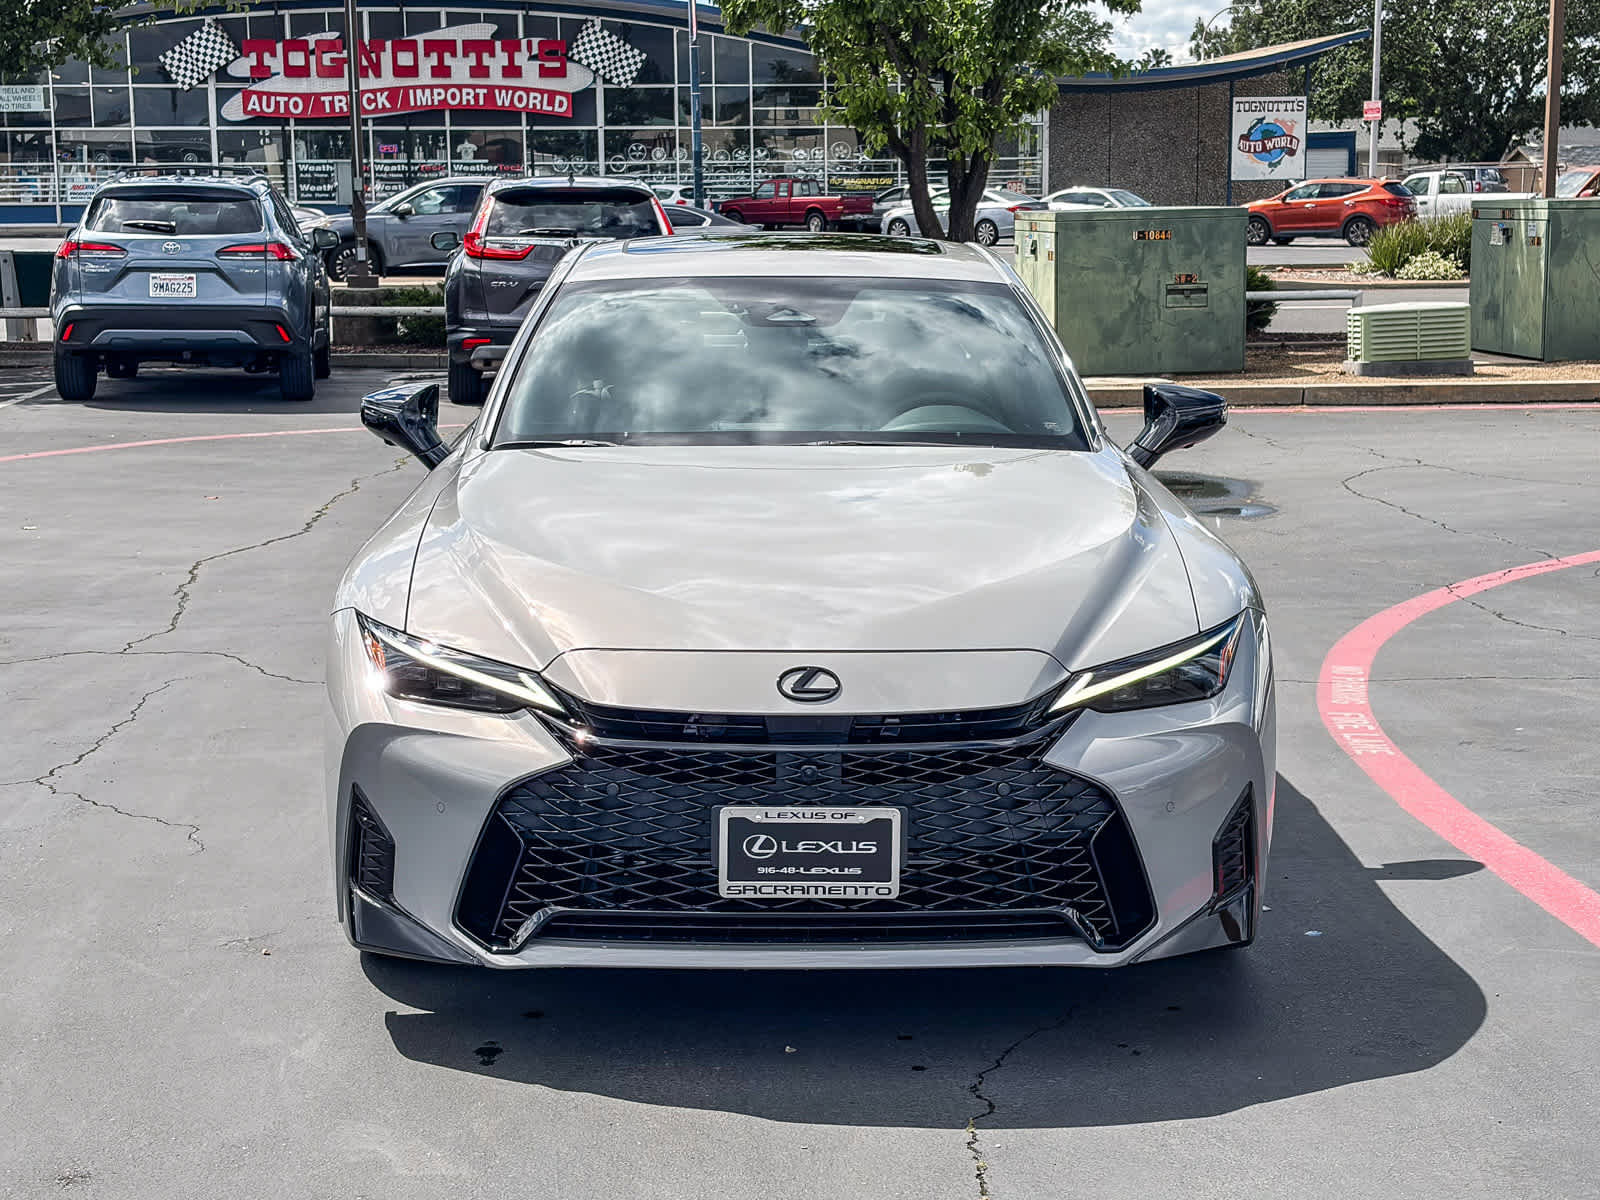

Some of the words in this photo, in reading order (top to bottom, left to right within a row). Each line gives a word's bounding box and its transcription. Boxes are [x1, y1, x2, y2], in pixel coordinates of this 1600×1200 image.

[242, 39, 567, 78] TOGNOTTI'S
[247, 94, 304, 114] AUTO
[320, 91, 392, 113] TRCK
[409, 87, 487, 107] IMPORT
[495, 88, 568, 113] WORLD
[1235, 98, 1305, 113] TOGNOTTI'S
[1239, 139, 1262, 153] AUTO
[1264, 135, 1298, 151] WORLD
[153, 282, 193, 293] 9MAG225
[764, 811, 827, 819] LEXUS
[831, 811, 856, 819] OF
[781, 840, 878, 854] LEXUS
[757, 866, 863, 875] 916-48-LEXUS
[726, 885, 892, 896] SACRAMENTO
